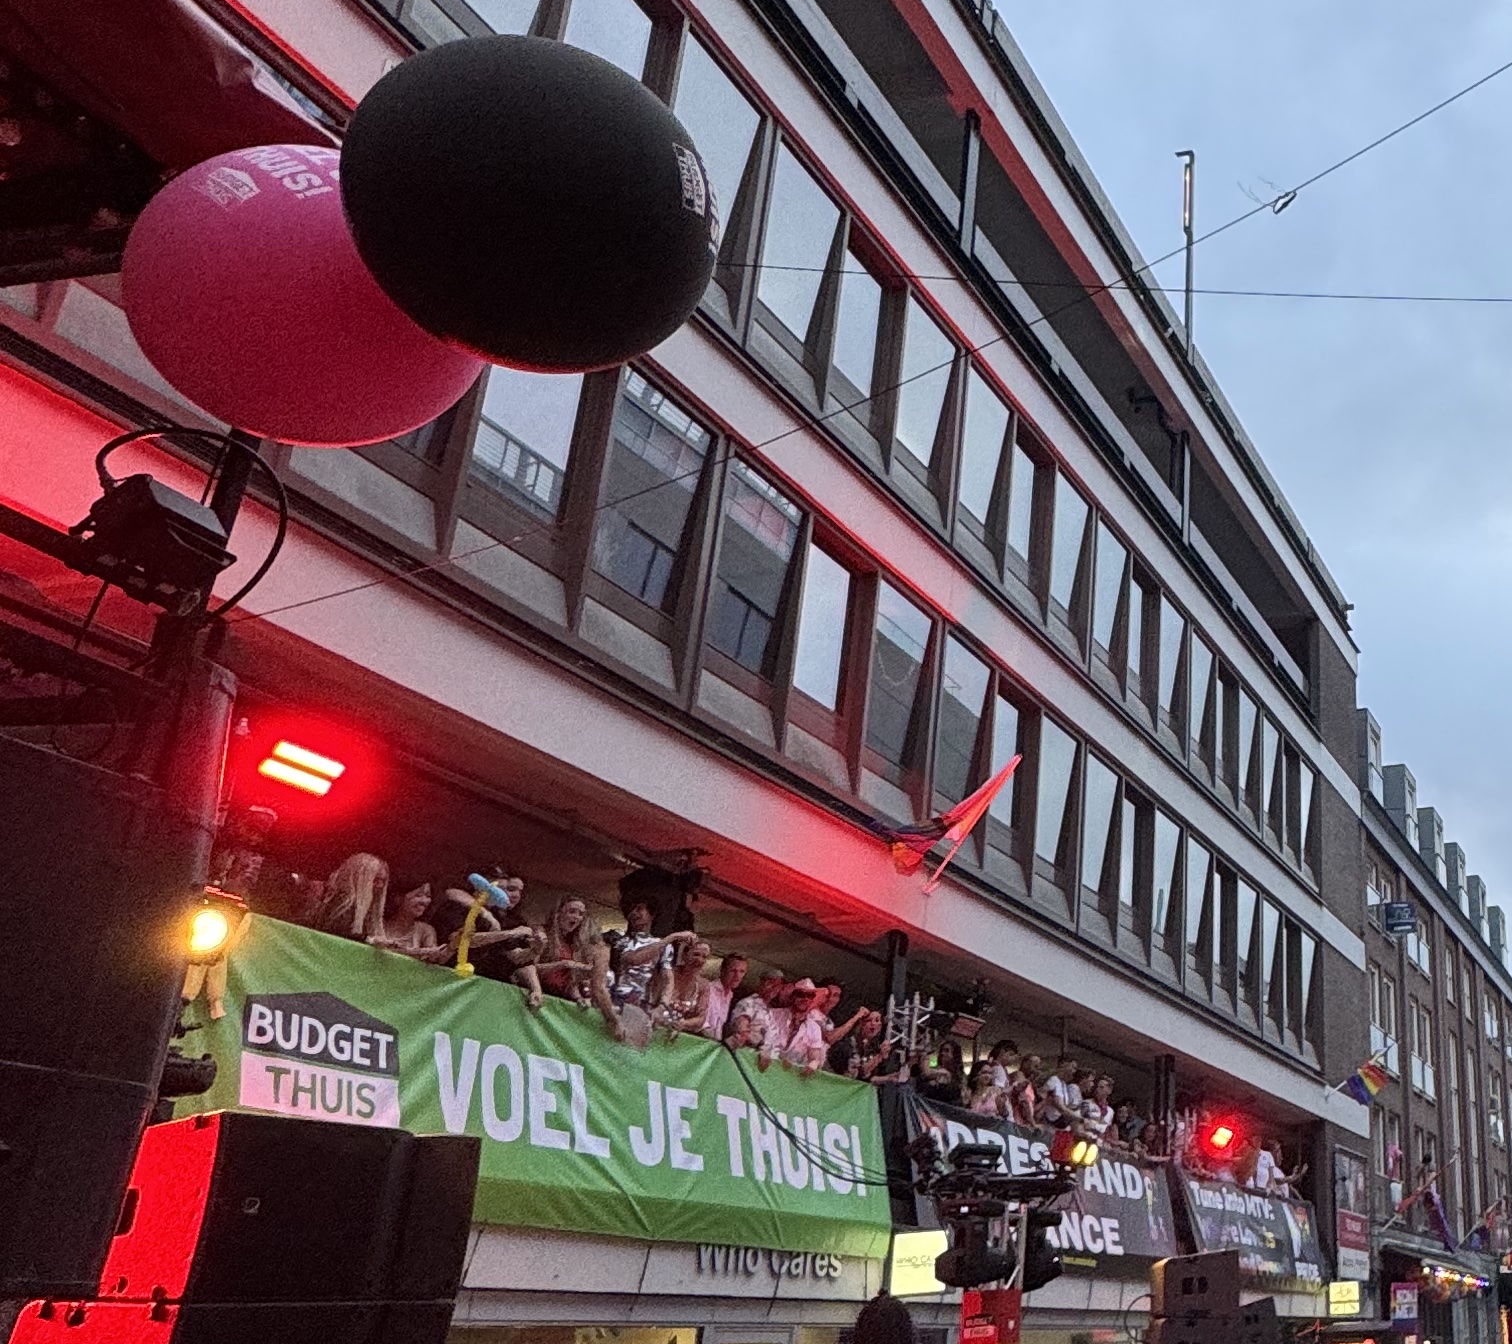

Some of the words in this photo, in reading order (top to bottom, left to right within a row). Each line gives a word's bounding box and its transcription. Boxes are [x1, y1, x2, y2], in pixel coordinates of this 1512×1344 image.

[247, 1003, 394, 1069] BUDGET
[265, 1065, 376, 1119] THUIS
[434, 1031, 610, 1158] VOEL
[628, 1080, 704, 1171] JE
[716, 1094, 867, 1197] THUIS!
